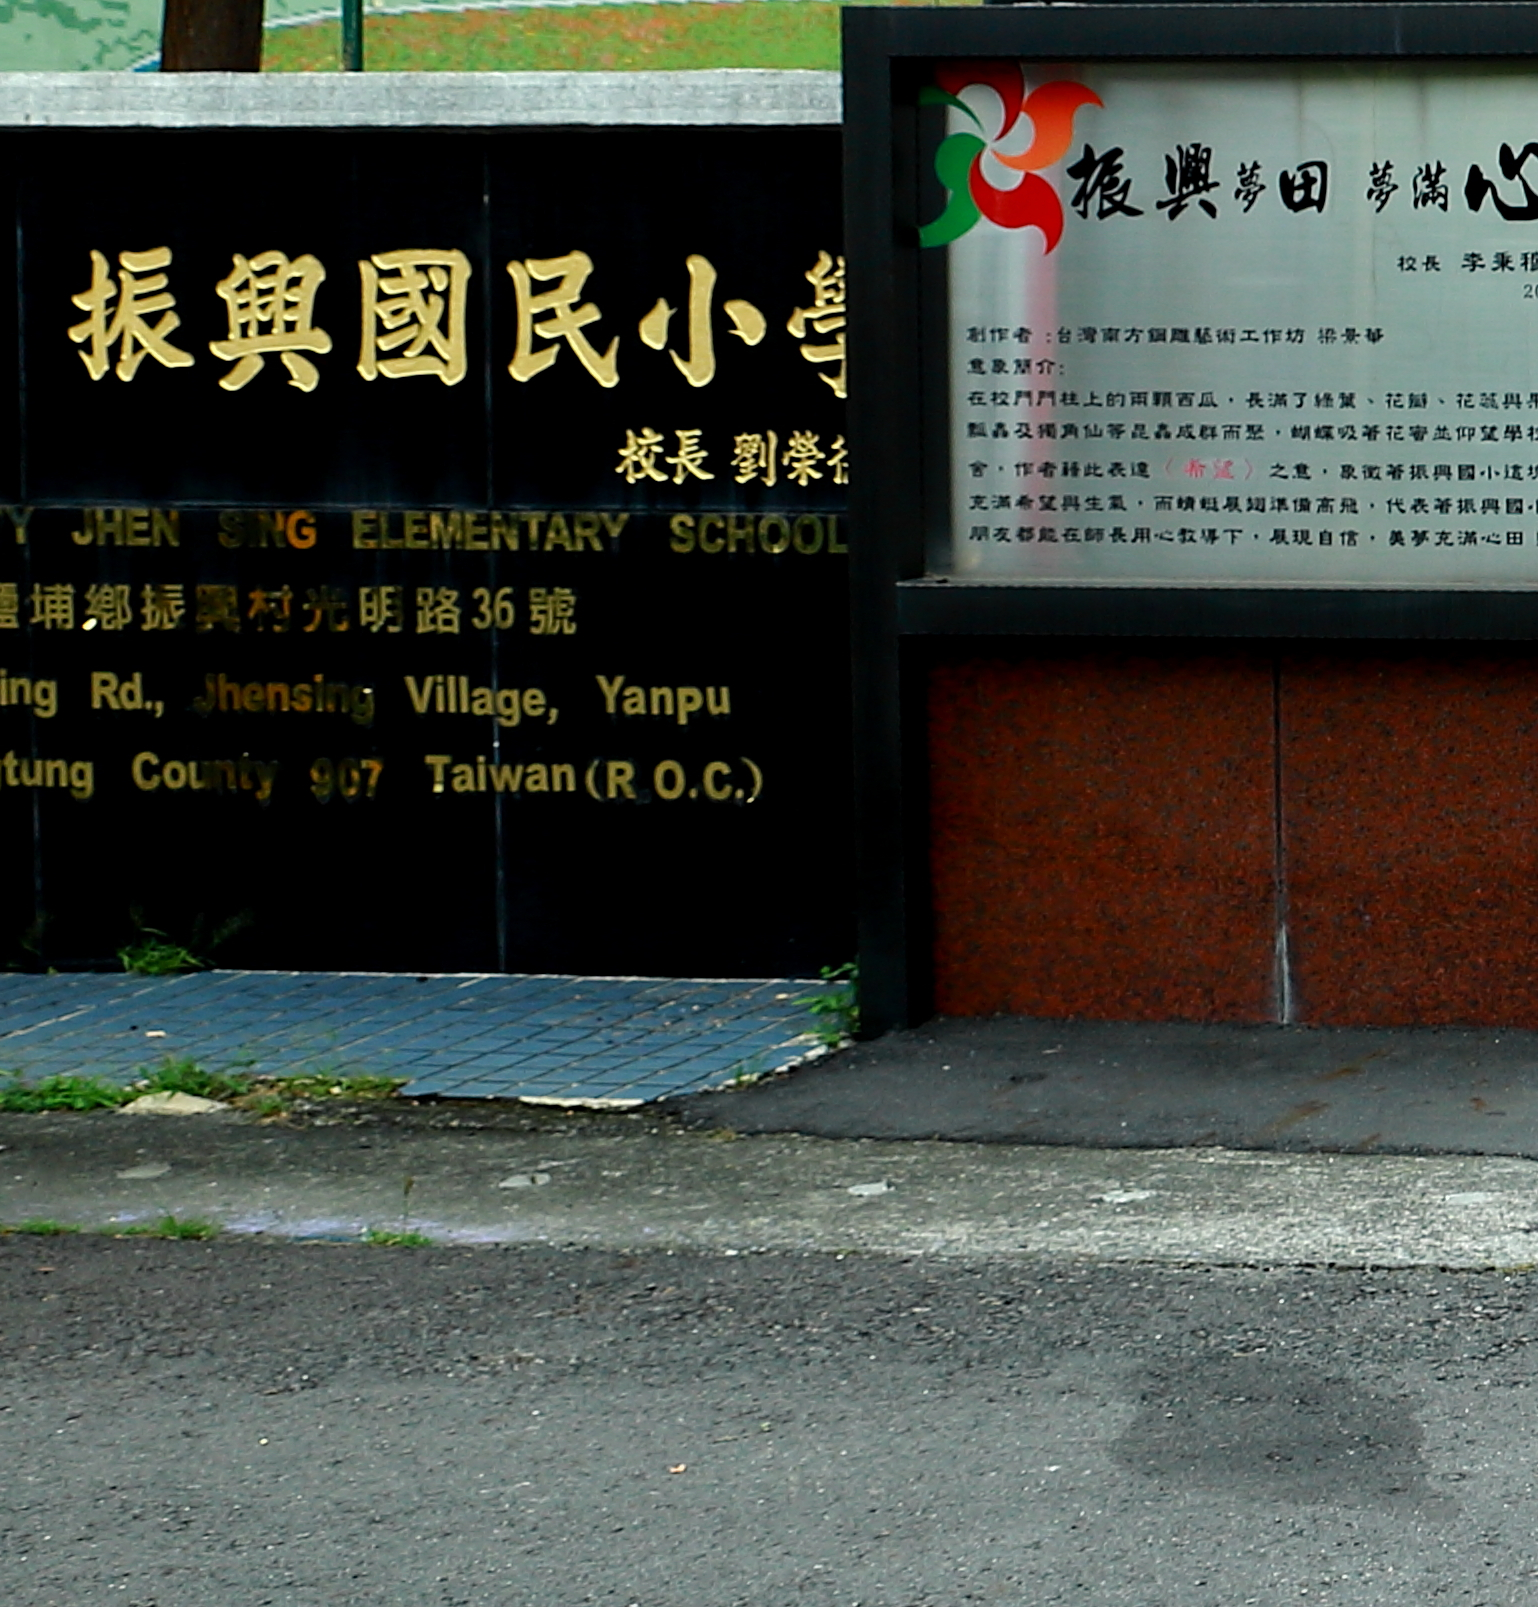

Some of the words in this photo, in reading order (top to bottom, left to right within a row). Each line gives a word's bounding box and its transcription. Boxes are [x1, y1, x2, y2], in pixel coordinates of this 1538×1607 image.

[1066, 142, 1329, 221] 振興夢田
[1397, 254, 1441, 272] 校長
[615, 427, 715, 485] 校長
[71, 509, 181, 548] JHEN
[217, 509, 318, 550] SING
[352, 509, 631, 552] ELEMENTARY
[669, 512, 849, 555] SCHOOL
[90, 671, 165, 719] Rd.,
[194, 673, 376, 726] Jhensing
[404, 674, 560, 727] Village,
[595, 674, 732, 726] Yanpu
[0, 750, 95, 800] tung
[132, 750, 280, 803] County
[310, 758, 384, 804] 907
